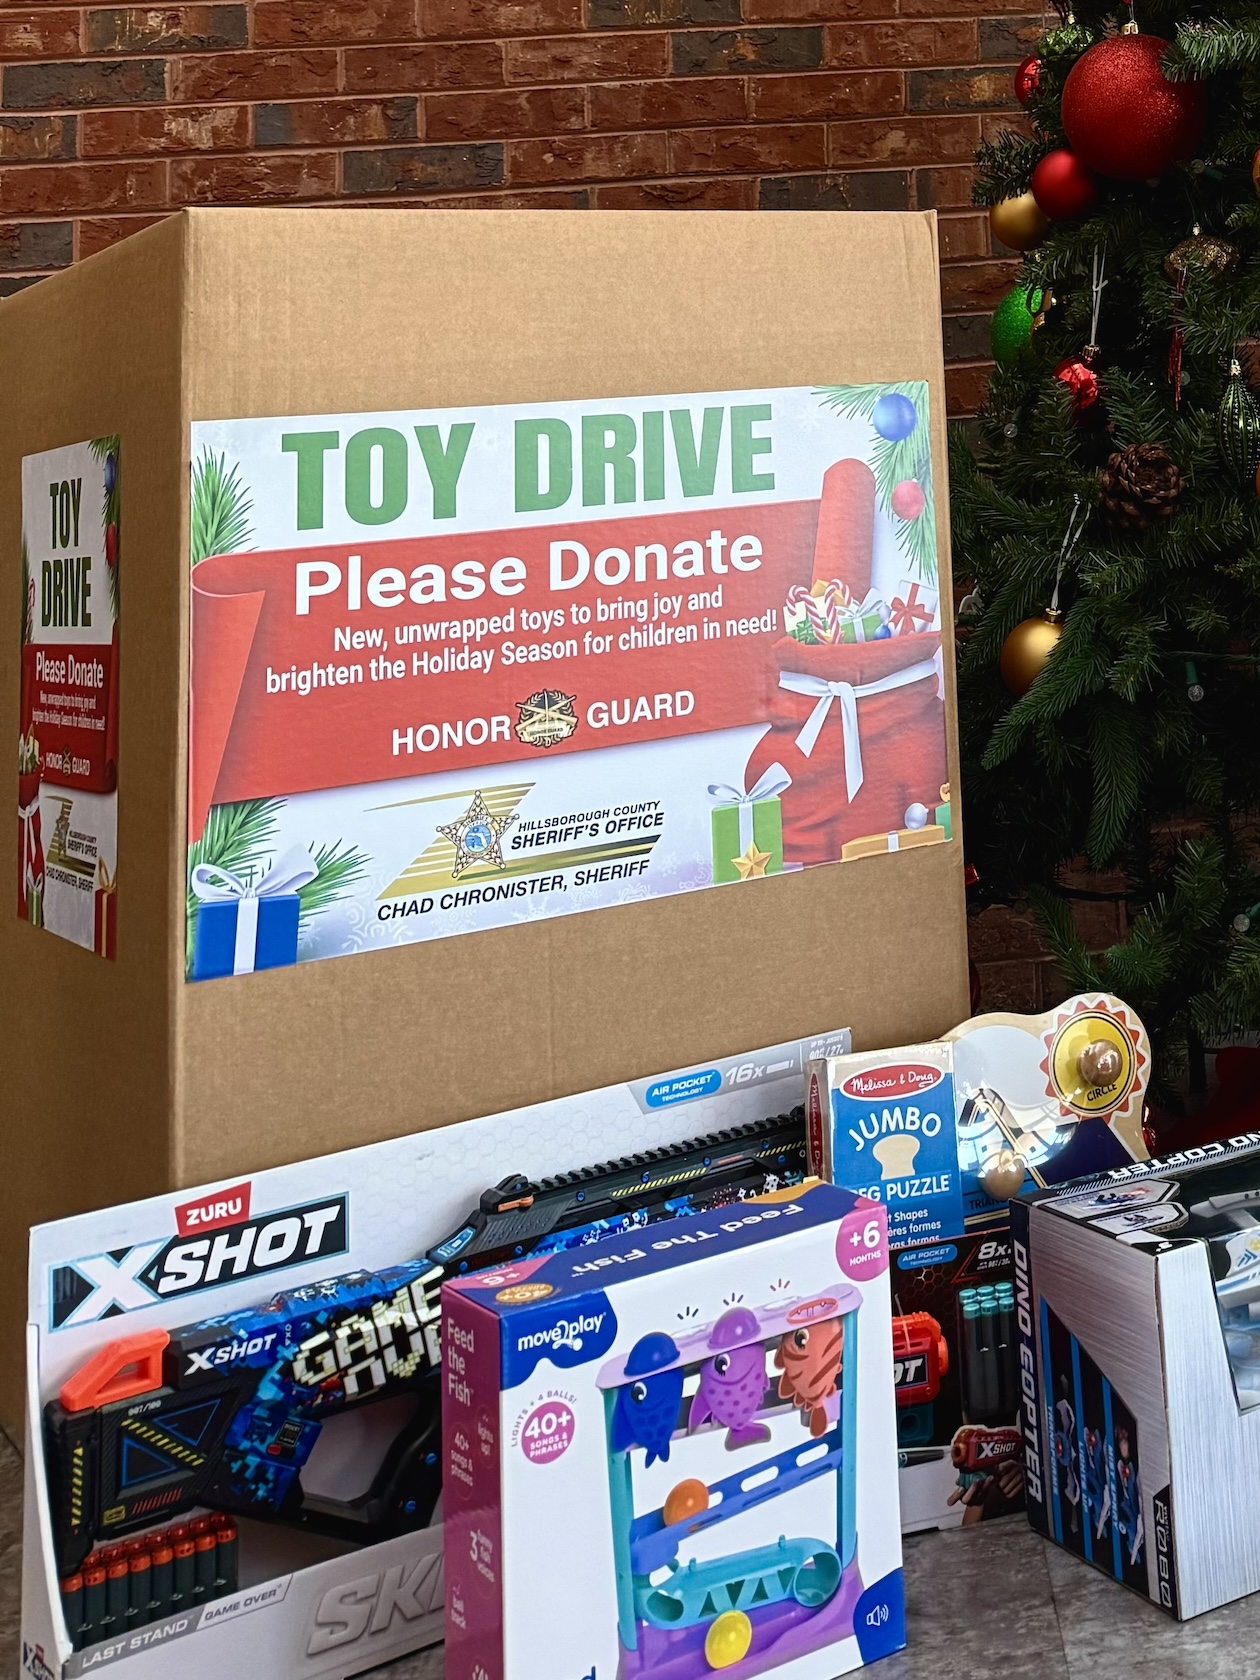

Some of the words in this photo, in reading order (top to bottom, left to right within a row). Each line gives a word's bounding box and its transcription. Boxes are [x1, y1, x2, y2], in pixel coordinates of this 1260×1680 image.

[282, 422, 476, 531] TOY
[514, 404, 776, 513] DRIVE
[50, 477, 82, 550] TOY
[295, 555, 527, 615] Please
[548, 529, 763, 592] Donate
[41, 557, 92, 627] DRIVE
[333, 626, 388, 653] New,
[395, 607, 515, 647] unwrapped
[519, 604, 565, 633] toys
[570, 603, 592, 624] to
[596, 596, 650, 627] bring
[651, 594, 683, 622] joy
[687, 585, 723, 610] and
[265, 661, 364, 695] brighten
[369, 656, 406, 680] the
[411, 645, 495, 678] Holiday
[500, 638, 578, 666] Season
[583, 632, 614, 655] for
[617, 621, 698, 652] children
[703, 617, 722, 639] in
[726, 608, 778, 637] need!
[36, 651, 66, 685] Please
[68, 653, 104, 689] Donate
[391, 715, 512, 756] HONOR
[587, 689, 695, 729] GUARD
[45, 751, 63, 770] HONOR
[71, 757, 91, 776] GUARD
[511, 823, 600, 850] SHERIFF'S
[604, 812, 665, 835] OFFICE
[518, 808, 610, 833] HILLSBOROUGH
[613, 800, 661, 817] COUNTY
[377, 898, 434, 921] CHAD
[440, 875, 569, 910] CHRONISTER,
[573, 860, 650, 887] SHERIFF
[651, 1083, 670, 1097] AIR
[671, 1074, 713, 1091] POCKET
[725, 1062, 766, 1086] 16x
[850, 1079, 897, 1094] Melissa
[908, 1071, 935, 1088] Doug
[661, 1086, 704, 1102] TECHNOLOGY
[811, 1083, 819, 1135] Melissa
[1086, 1084, 1118, 1103] CIRCLE
[849, 1106, 942, 1152] JUMBO
[1107, 1144, 1226, 1180] COPTER
[886, 1175, 950, 1201] PUZZLE
[186, 1197, 243, 1226] ZURU
[719, 1202, 805, 1233] Feed
[894, 1208, 929, 1222] Shapes
[908, 1220, 942, 1234] formes
[650, 1227, 719, 1251] The
[849, 1220, 881, 1249] +6
[977, 1241, 1008, 1260] 8x
[571, 1249, 648, 1276] Fish
[849, 1250, 882, 1267] MONTHS
[902, 1253, 917, 1262] AIR
[918, 1247, 951, 1260] POCKET
[1013, 1239, 1032, 1337] DINO
[447, 1317, 475, 1353] Feed
[447, 1346, 466, 1375] the
[447, 1373, 471, 1406] Fish
[477, 1422, 494, 1444] lights
[511, 1408, 529, 1447] LIGHTS
[546, 1390, 578, 1404] BALLS!
[524, 1410, 572, 1439] 40+
[1019, 1342, 1043, 1504] COPTER
[454, 1431, 470, 1451] 40+
[529, 1439, 569, 1458] PHRASES
[530, 1434, 560, 1450] SONGS
[978, 1441, 1016, 1460] XSHOT
[1077, 1441, 1087, 1493] LIGHTS
[1107, 1444, 1117, 1480] MIST
[1110, 1482, 1119, 1532] SPRAY
[470, 1530, 478, 1562] 3
[203, 1600, 241, 1622] GAME
[243, 1586, 278, 1611] OVER
[81, 1639, 127, 1669] LAST
[129, 1617, 190, 1650] STAND
